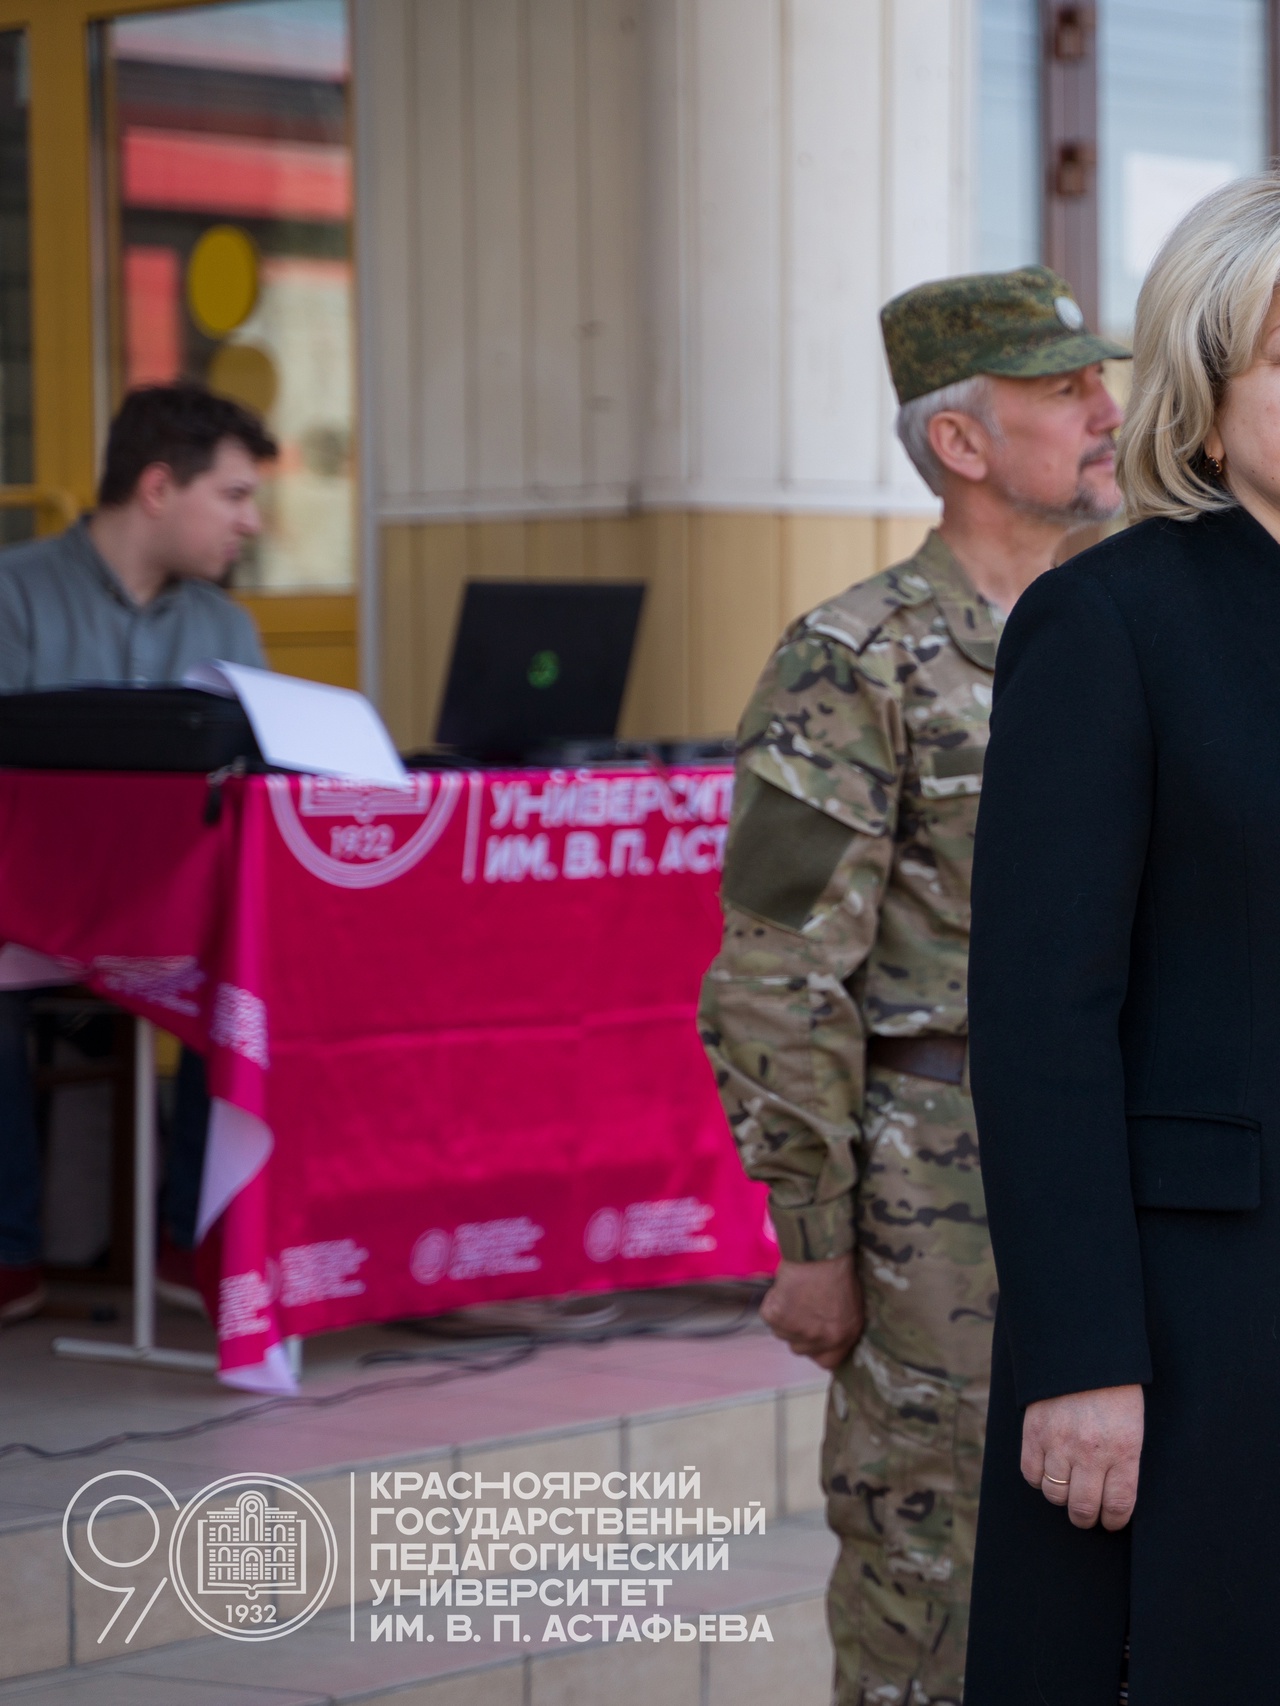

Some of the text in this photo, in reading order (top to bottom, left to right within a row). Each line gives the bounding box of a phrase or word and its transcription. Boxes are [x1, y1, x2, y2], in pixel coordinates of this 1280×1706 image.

[329, 823, 395, 860] 1932
[484, 832, 558, 883] ИМ.
[562, 830, 607, 880] В.
[609, 827, 655, 877] П.
